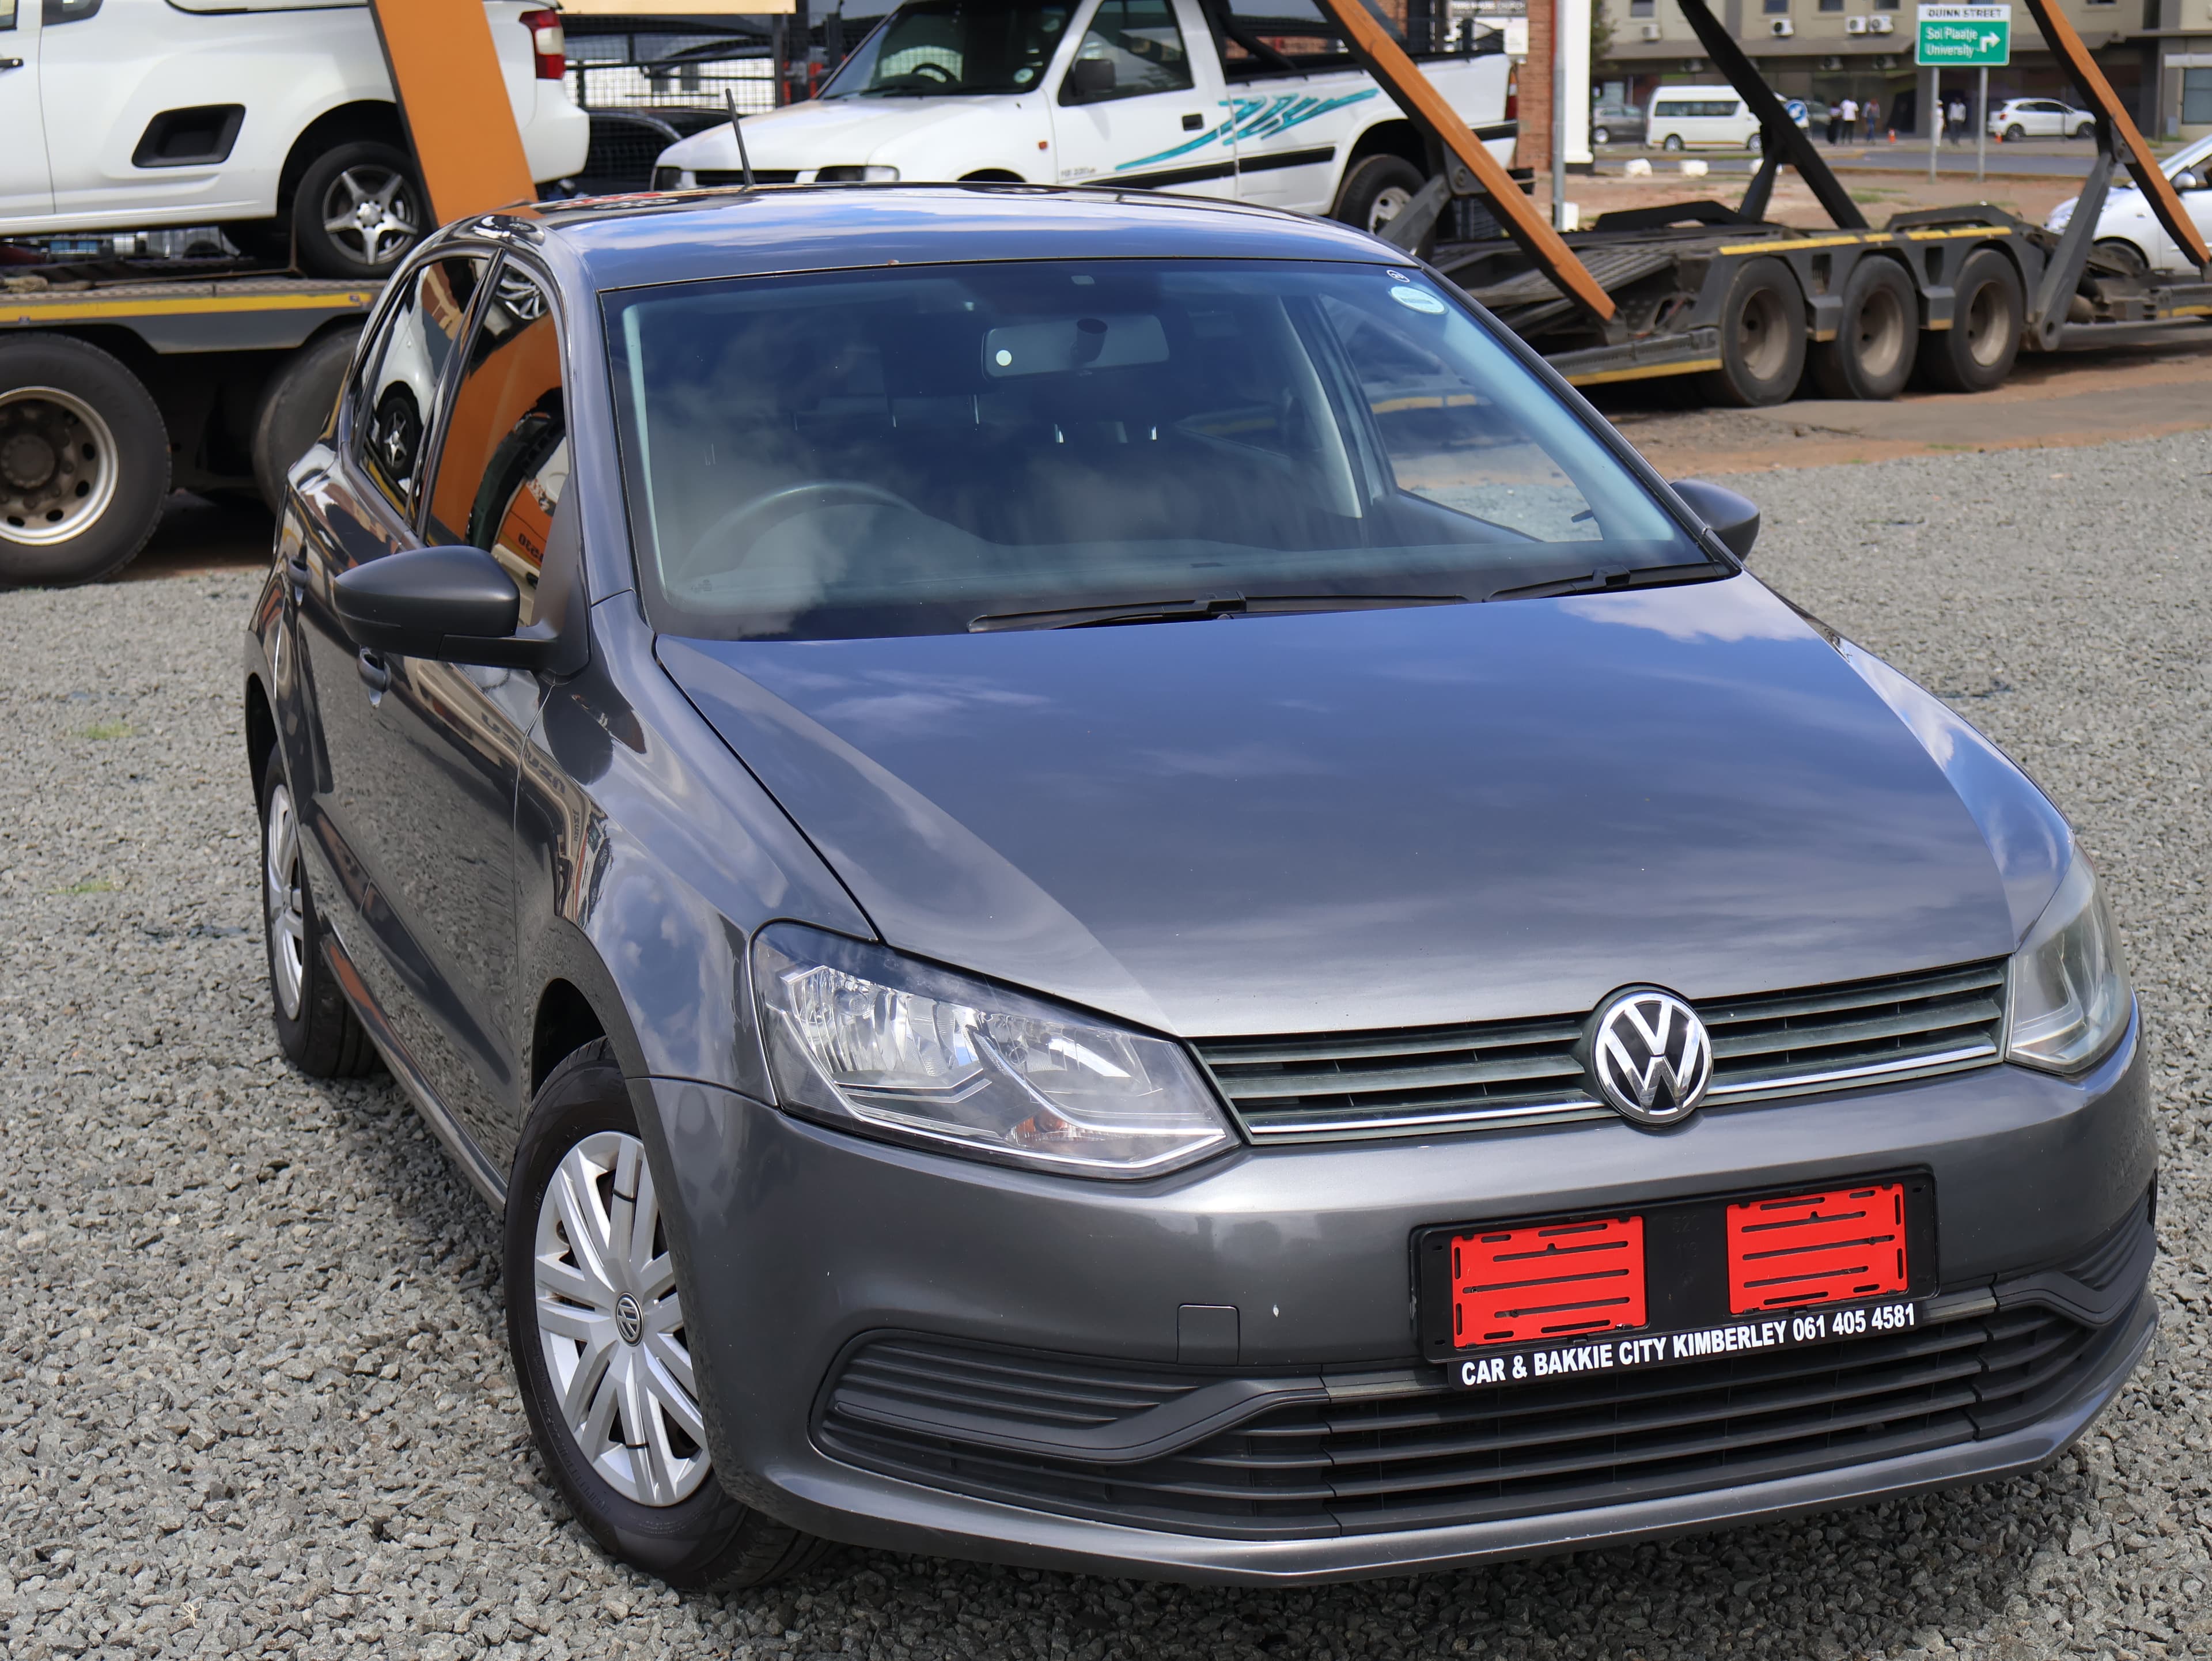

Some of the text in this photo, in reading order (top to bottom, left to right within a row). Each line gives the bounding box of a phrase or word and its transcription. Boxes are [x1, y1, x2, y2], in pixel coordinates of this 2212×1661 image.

[1929, 9, 2002, 18] QUINN STREET
[1926, 27, 1978, 42] Sol Plaatje
[1926, 43, 1974, 58] University
[1461, 1303, 1915, 1386] CAR & BAKKIE CITY KIMBERLEY 061 405 4581
